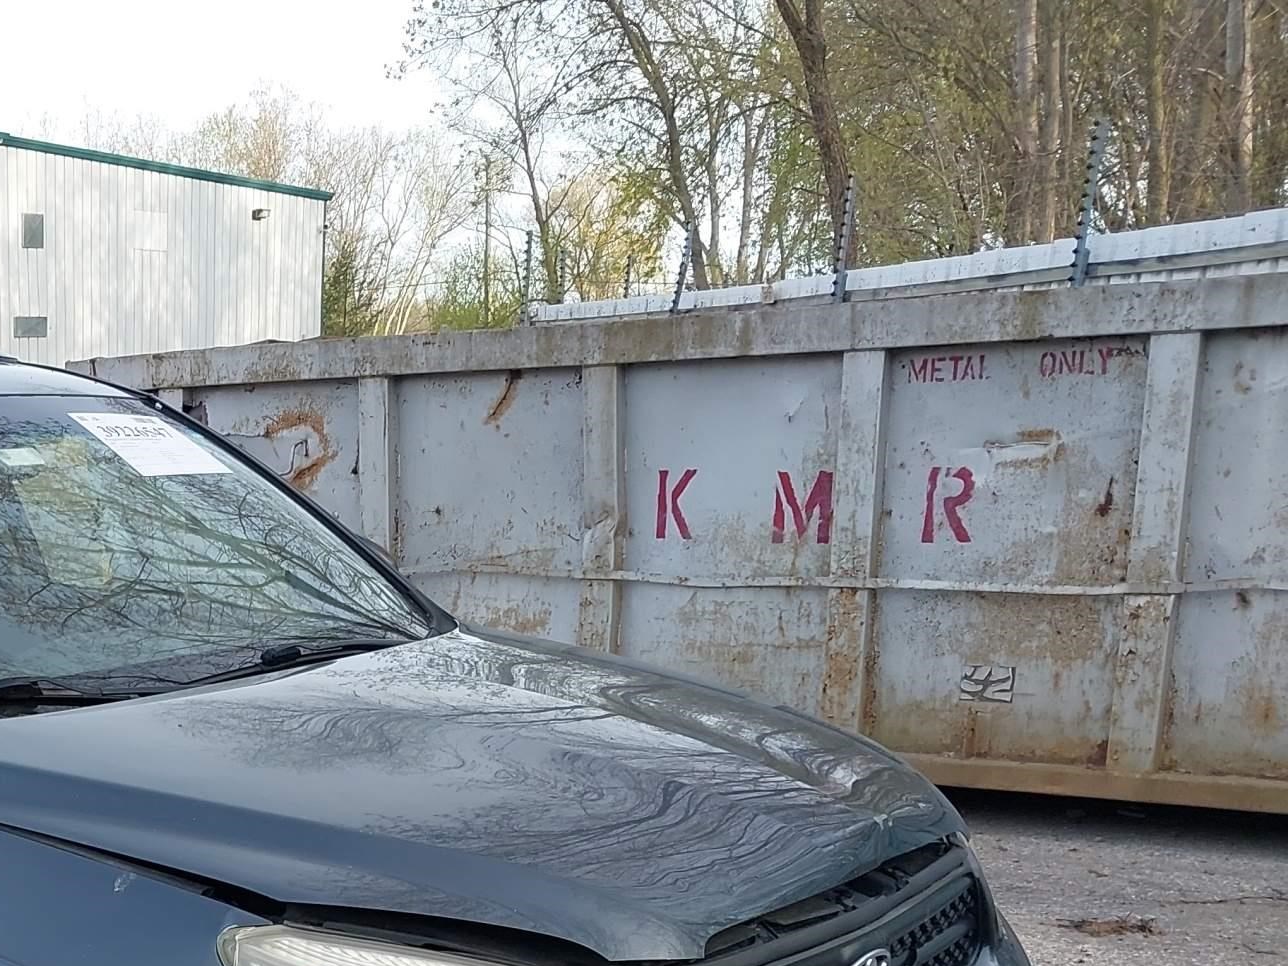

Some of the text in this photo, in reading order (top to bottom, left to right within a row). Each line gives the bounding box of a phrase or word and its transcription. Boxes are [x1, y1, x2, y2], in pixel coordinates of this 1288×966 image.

[908, 347, 1112, 383] METAL ONLY
[655, 466, 976, 544] K M R
